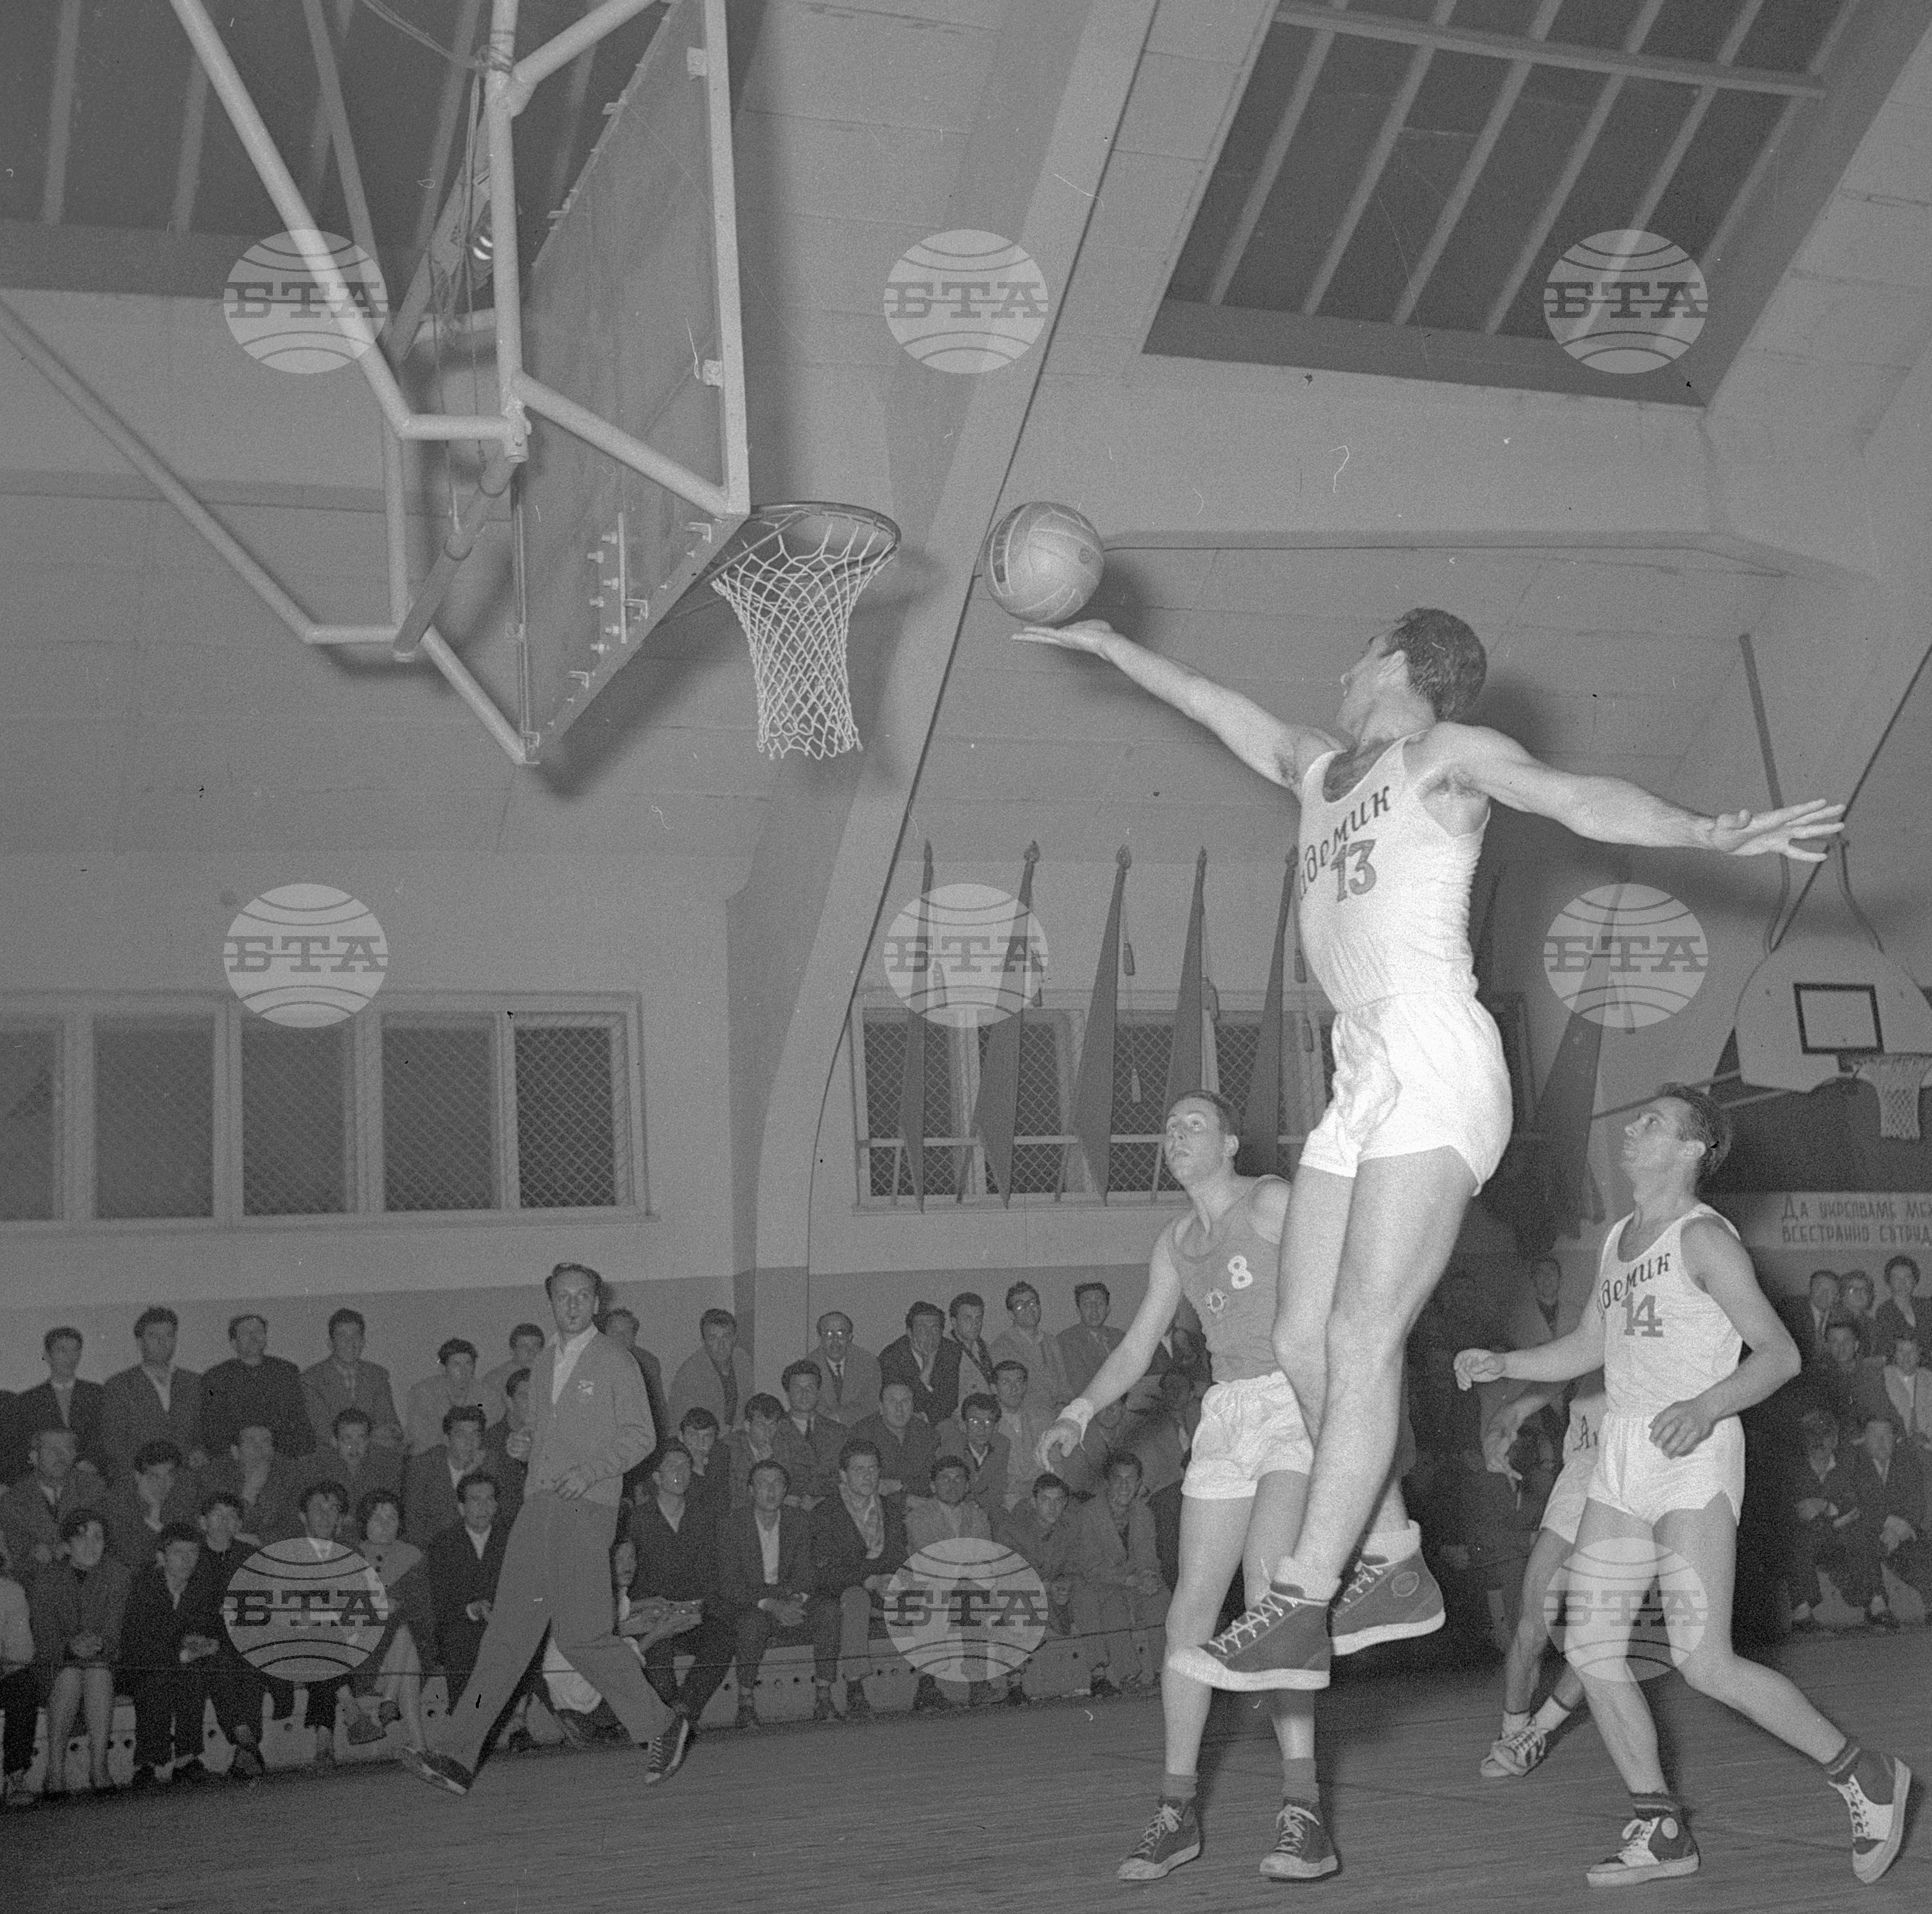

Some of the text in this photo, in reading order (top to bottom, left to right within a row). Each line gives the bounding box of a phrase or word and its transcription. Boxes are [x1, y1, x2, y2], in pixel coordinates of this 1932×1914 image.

[1301, 786, 1390, 900] демик
[1331, 839, 1377, 902] 13
[1227, 1256, 1253, 1289] 8
[1621, 1292, 1663, 1337] 14
